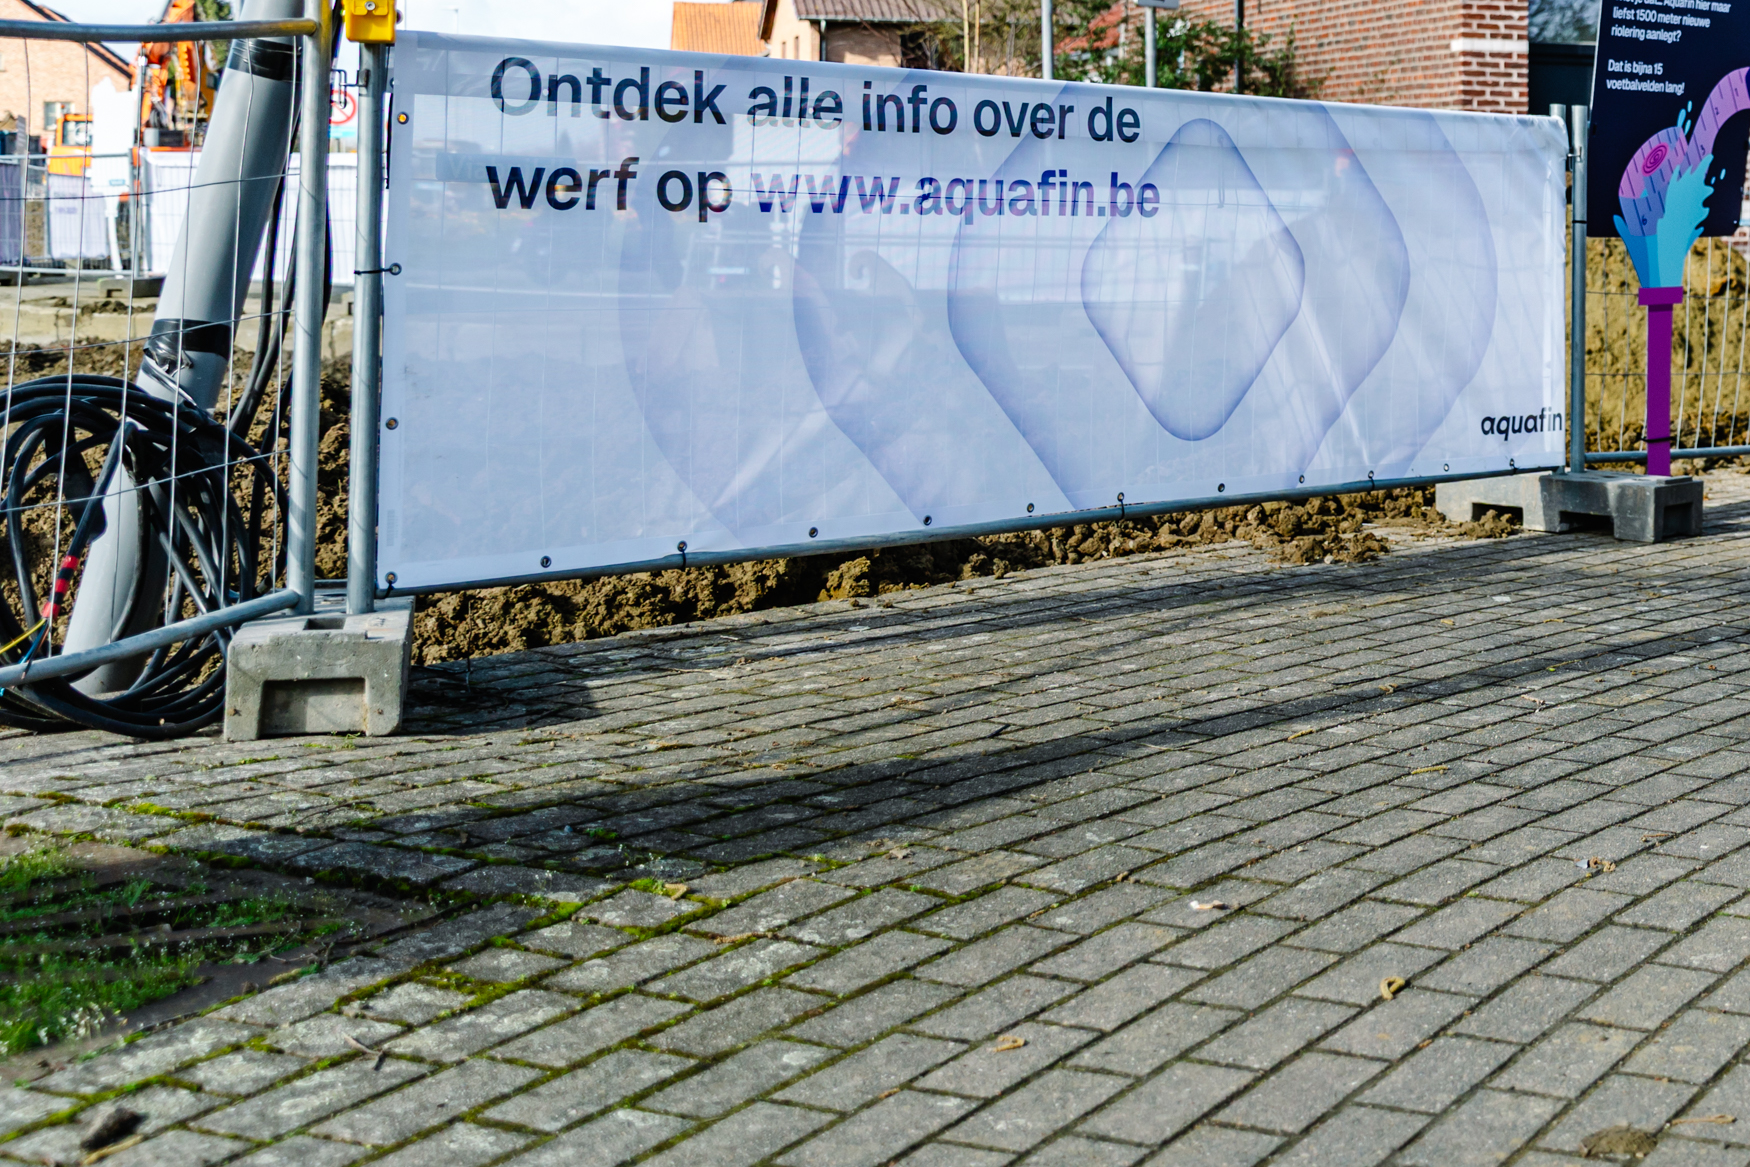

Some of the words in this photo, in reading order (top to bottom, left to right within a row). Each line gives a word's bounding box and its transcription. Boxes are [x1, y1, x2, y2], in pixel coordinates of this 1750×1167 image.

[1612, 6, 1635, 21] liefst
[1635, 9, 1657, 23] 1500
[1657, 13, 1682, 25] meter
[1682, 14, 1711, 28] nieuwe
[1710, 1, 1731, 13] maar
[1611, 24, 1646, 41] riolering
[1645, 29, 1682, 44] aanlegt?
[1607, 59, 1624, 73] Dat
[1624, 60, 1633, 73] is
[1632, 61, 1653, 76] bijna
[1653, 63, 1663, 75] 15
[1606, 78, 1665, 93] voetbalvelden
[1665, 81, 1685, 96] lang!
[490, 56, 728, 126] Ontdek
[746, 75, 844, 131] alle
[862, 80, 959, 135] info
[973, 97, 1075, 141] over
[1087, 96, 1141, 144] de
[485, 156, 641, 211] werf
[656, 169, 733, 223] op
[750, 169, 1161, 225] www.aquafin.be
[1480, 406, 1563, 442] aquafin
